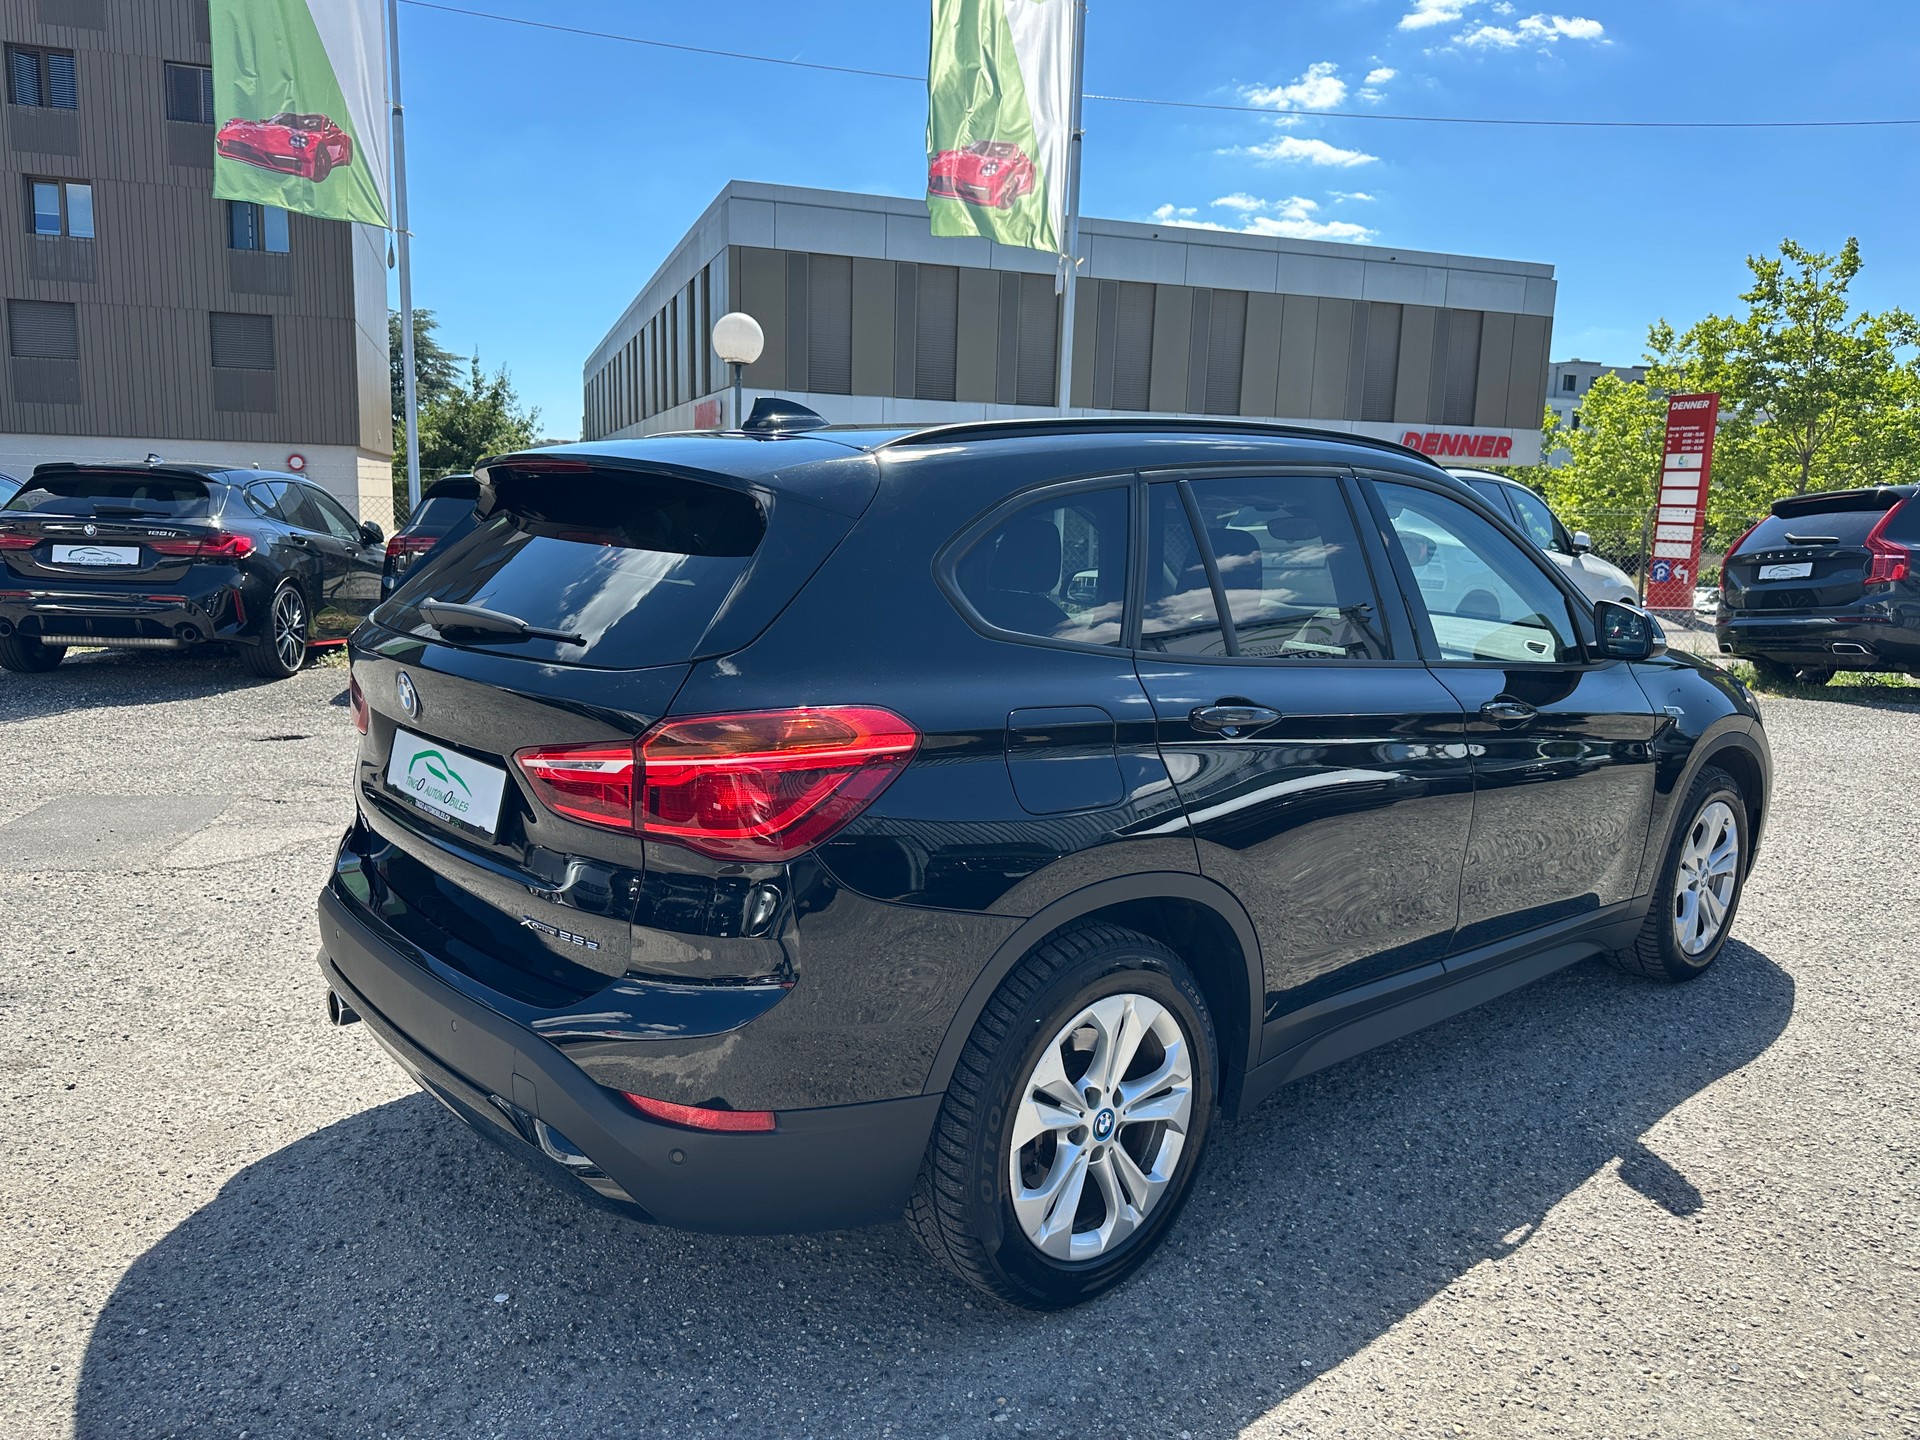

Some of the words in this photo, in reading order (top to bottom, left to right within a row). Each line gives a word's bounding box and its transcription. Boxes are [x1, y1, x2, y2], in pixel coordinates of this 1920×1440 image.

[1671, 400, 1710, 411] DENNER
[1402, 432, 1513, 459] DENNER
[1657, 568, 1666, 580] P
[405, 775, 426, 791] TINGO
[424, 785, 470, 813] AUTOMOBILES
